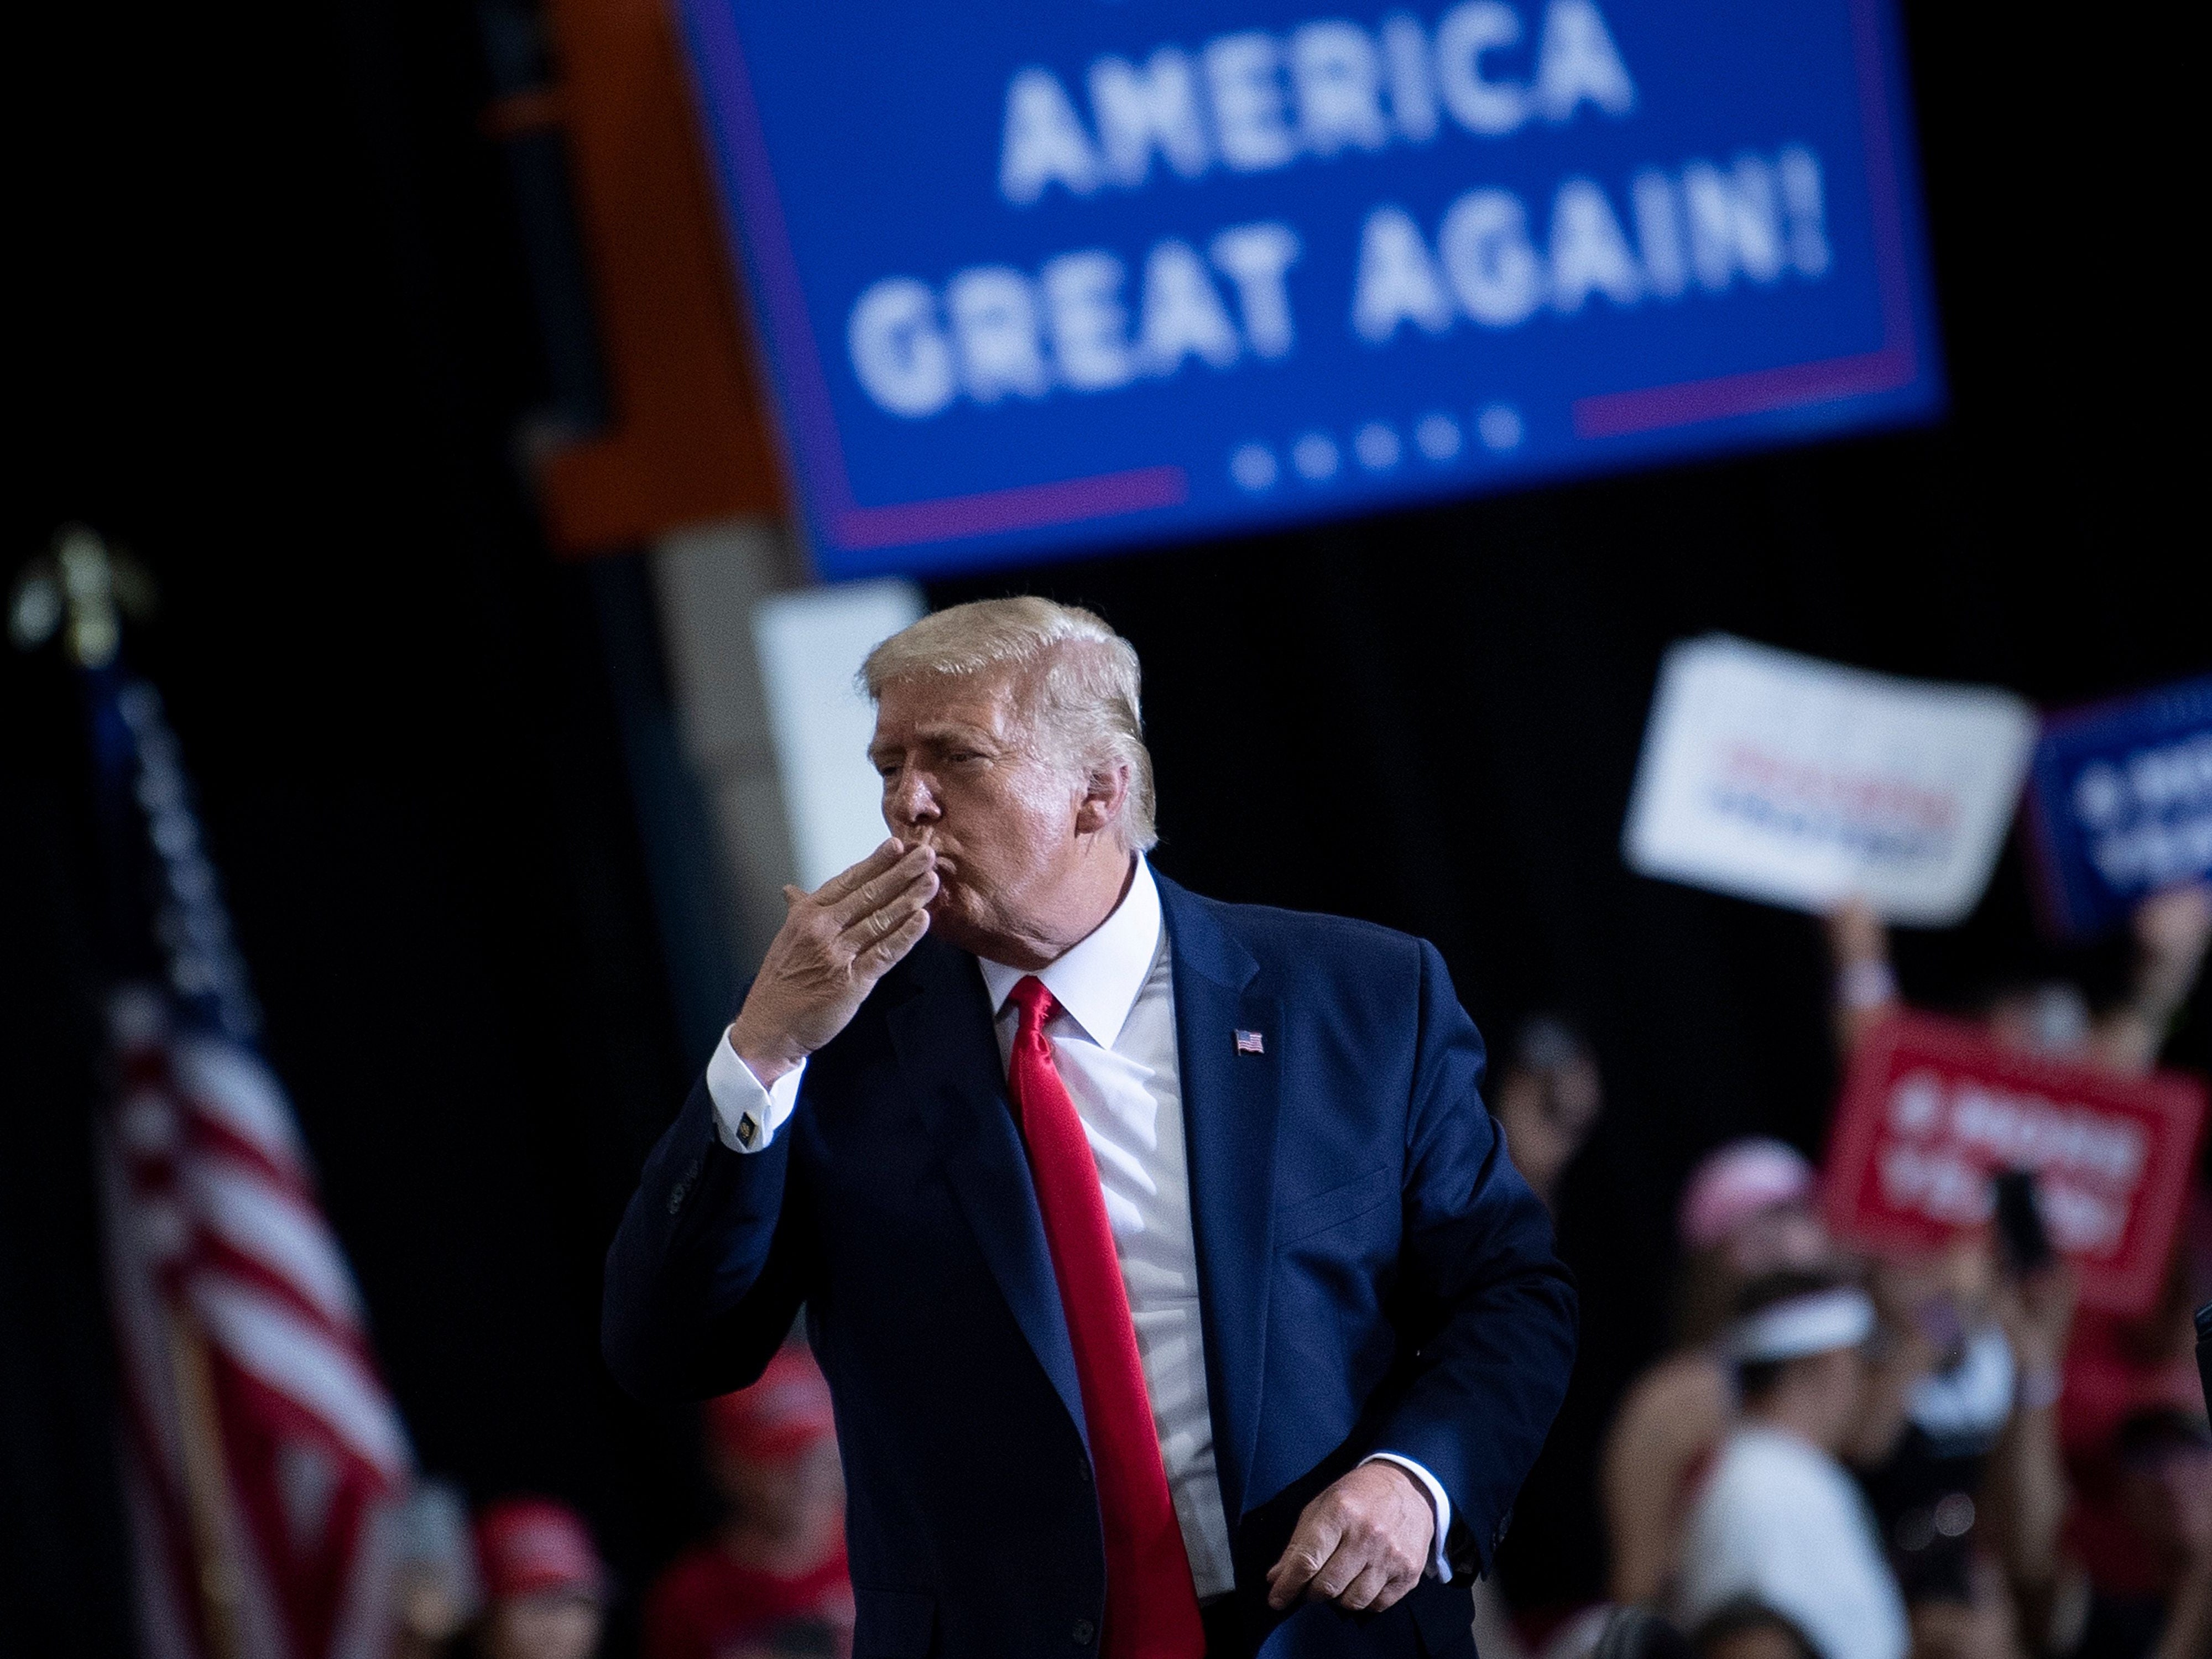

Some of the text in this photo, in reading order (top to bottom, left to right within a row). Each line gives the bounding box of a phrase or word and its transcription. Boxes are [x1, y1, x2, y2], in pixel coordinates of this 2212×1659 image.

[1000, 0, 1636, 204] AMERICA
[849, 146, 1829, 416] GREAT AGAIN!
